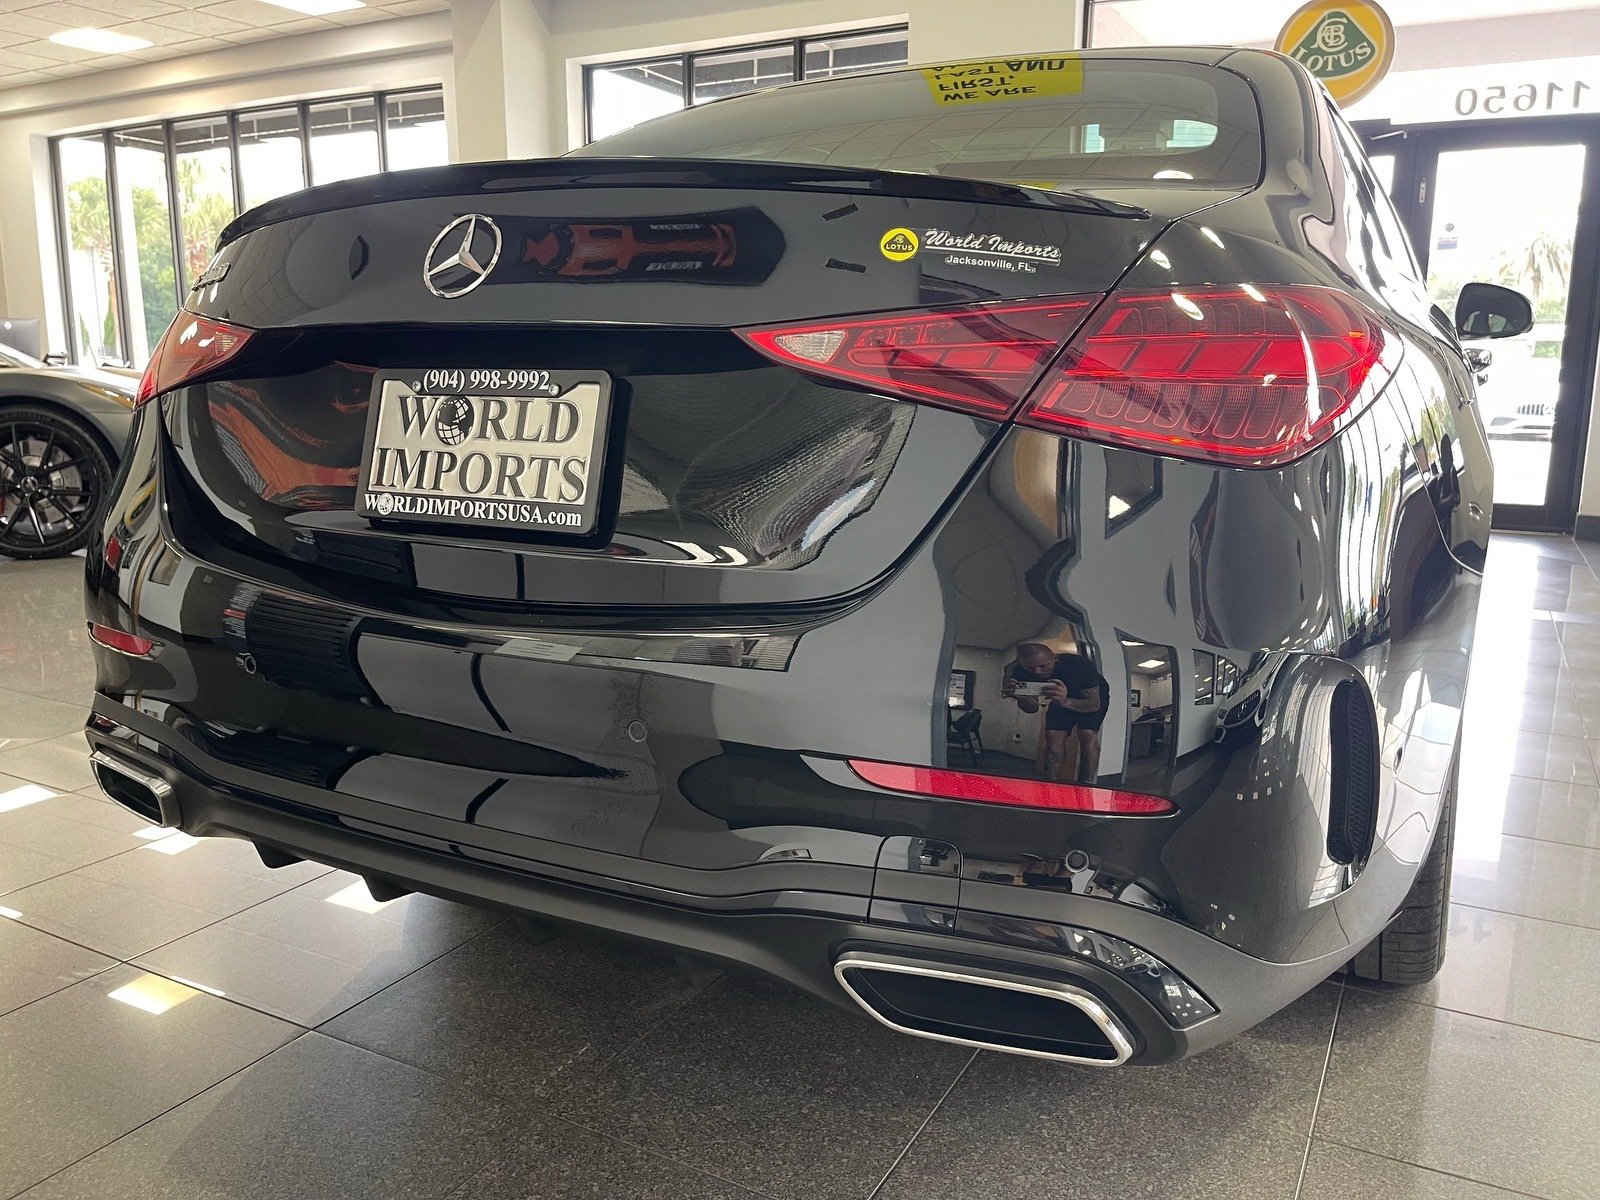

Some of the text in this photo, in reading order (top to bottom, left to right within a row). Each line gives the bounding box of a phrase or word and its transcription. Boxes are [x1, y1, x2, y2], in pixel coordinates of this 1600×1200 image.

[1294, 41, 1372, 72] LOTUS
[885, 243, 914, 251] LOTUS
[925, 230, 984, 249] World
[988, 236, 1061, 258] Imports
[945, 254, 1015, 272] Jacksonville,
[423, 370, 550, 393] (904) 998-9992
[398, 395, 581, 446] WORLD
[371, 448, 588, 502] IMPORTS
[364, 492, 582, 527] WORLDIMPORTSUSA.com
